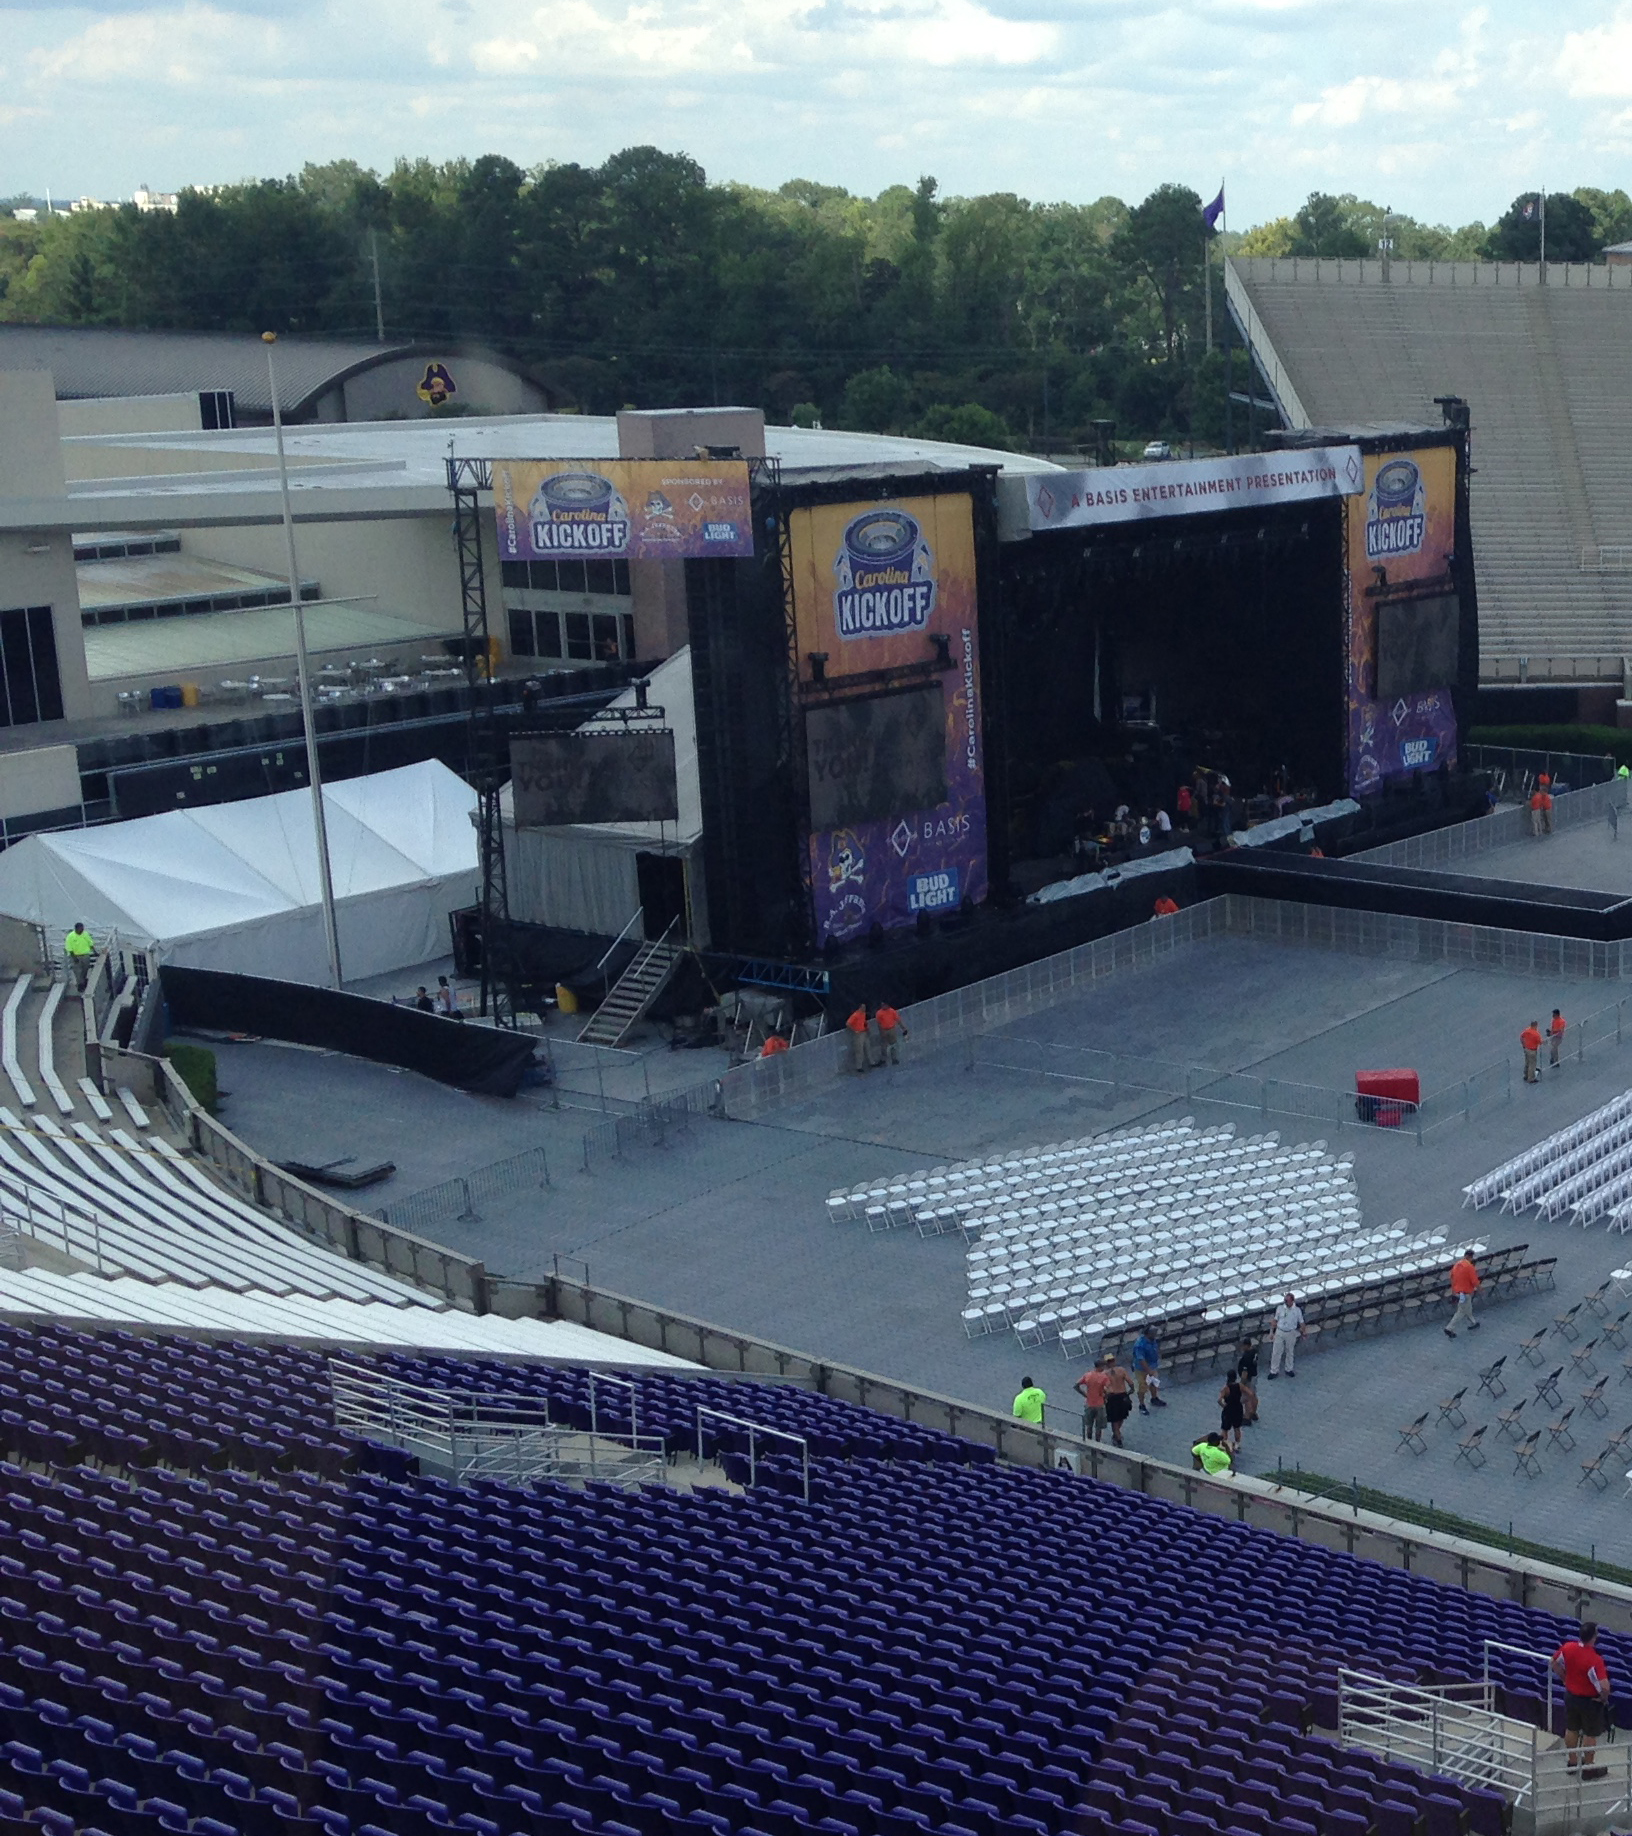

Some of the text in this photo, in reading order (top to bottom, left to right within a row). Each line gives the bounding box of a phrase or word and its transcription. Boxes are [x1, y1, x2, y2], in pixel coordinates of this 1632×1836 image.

[661, 477, 711, 486] SPONSORED
[1071, 466, 1337, 508] A BASIS ENTERTAINMENT PRESENTATION
[710, 495, 744, 506] BASIS
[552, 508, 606, 522] Carolina
[537, 523, 626, 548] KICKOFF
[704, 530, 735, 540] LIGHT
[708, 523, 731, 531] BUD
[1369, 517, 1421, 553] KICKOFF
[855, 566, 909, 589] Carolina
[842, 586, 928, 631] KICKOFF
[962, 628, 977, 770] #CarolinaKickoff
[1405, 740, 1428, 755] BUD
[924, 814, 971, 839] BASIS
[916, 874, 949, 893] BUD
[910, 887, 956, 909] LIGHT
